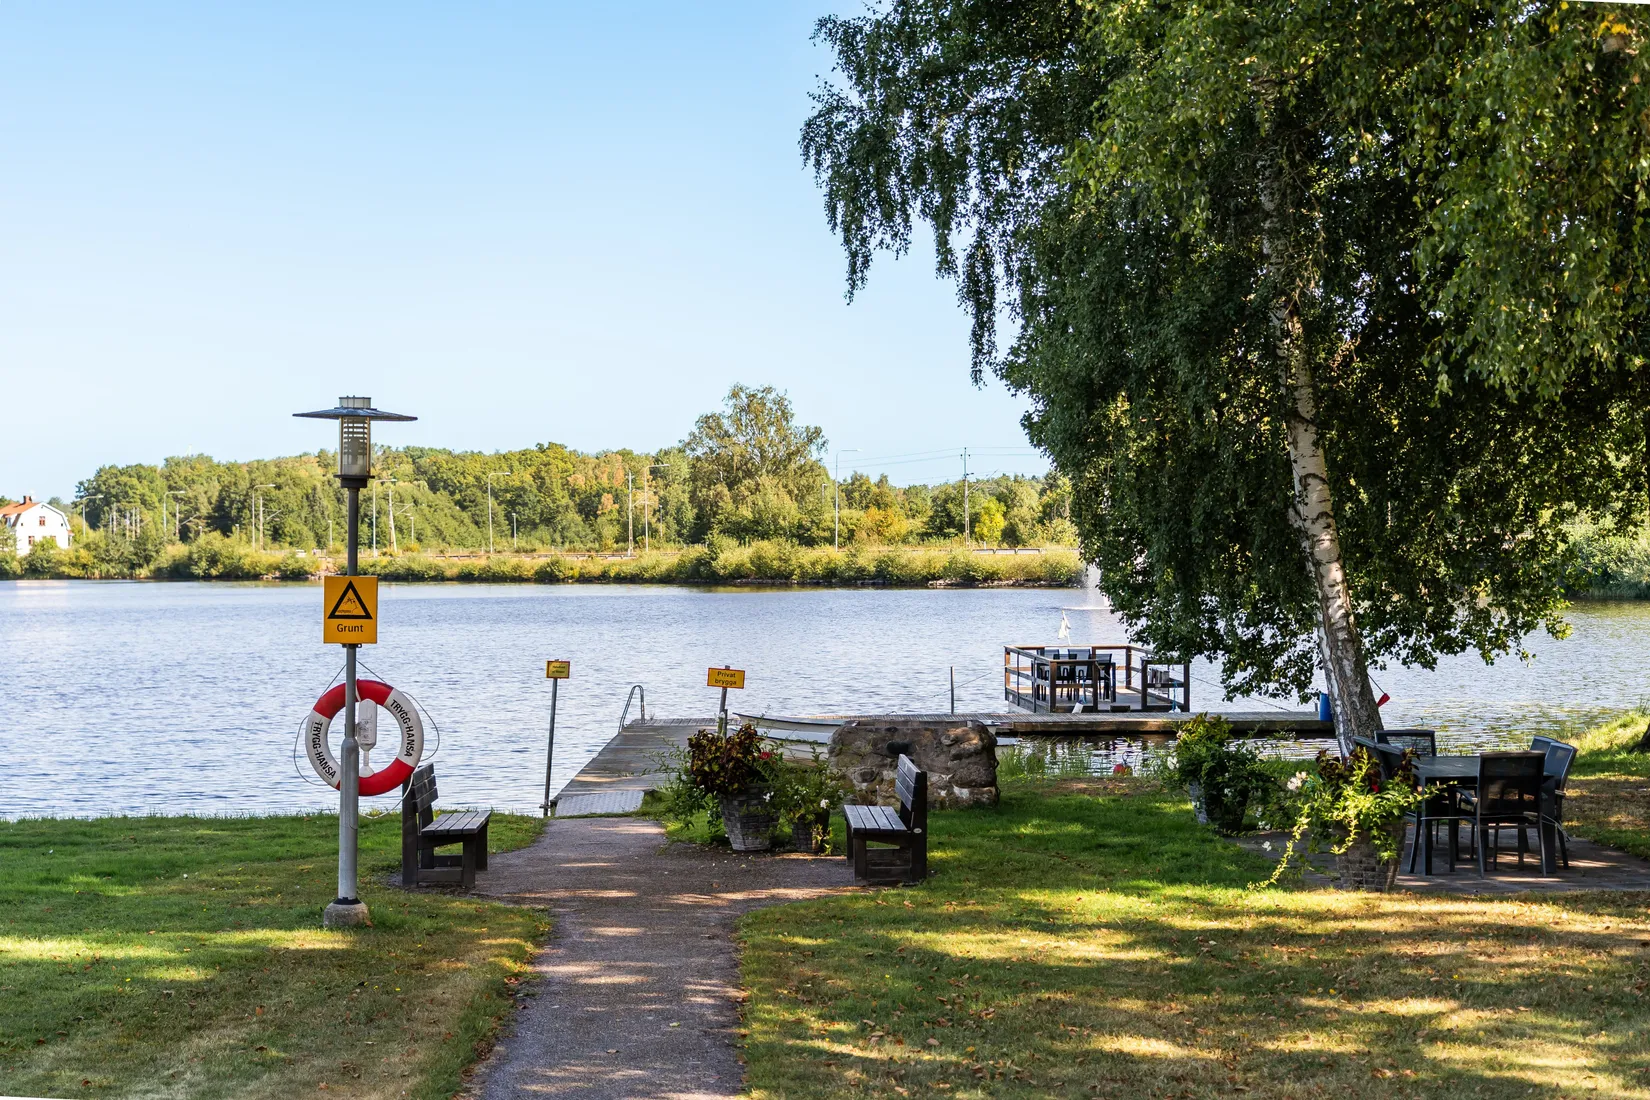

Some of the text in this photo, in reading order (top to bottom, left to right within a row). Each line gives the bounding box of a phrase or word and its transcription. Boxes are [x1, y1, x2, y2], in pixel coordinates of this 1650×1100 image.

[336, 623, 364, 633] Grunt
[714, 678, 737, 686] brygga
[390, 699, 415, 757] TRYGG-HANSA
[312, 721, 337, 779] TRYGG-HANSA
